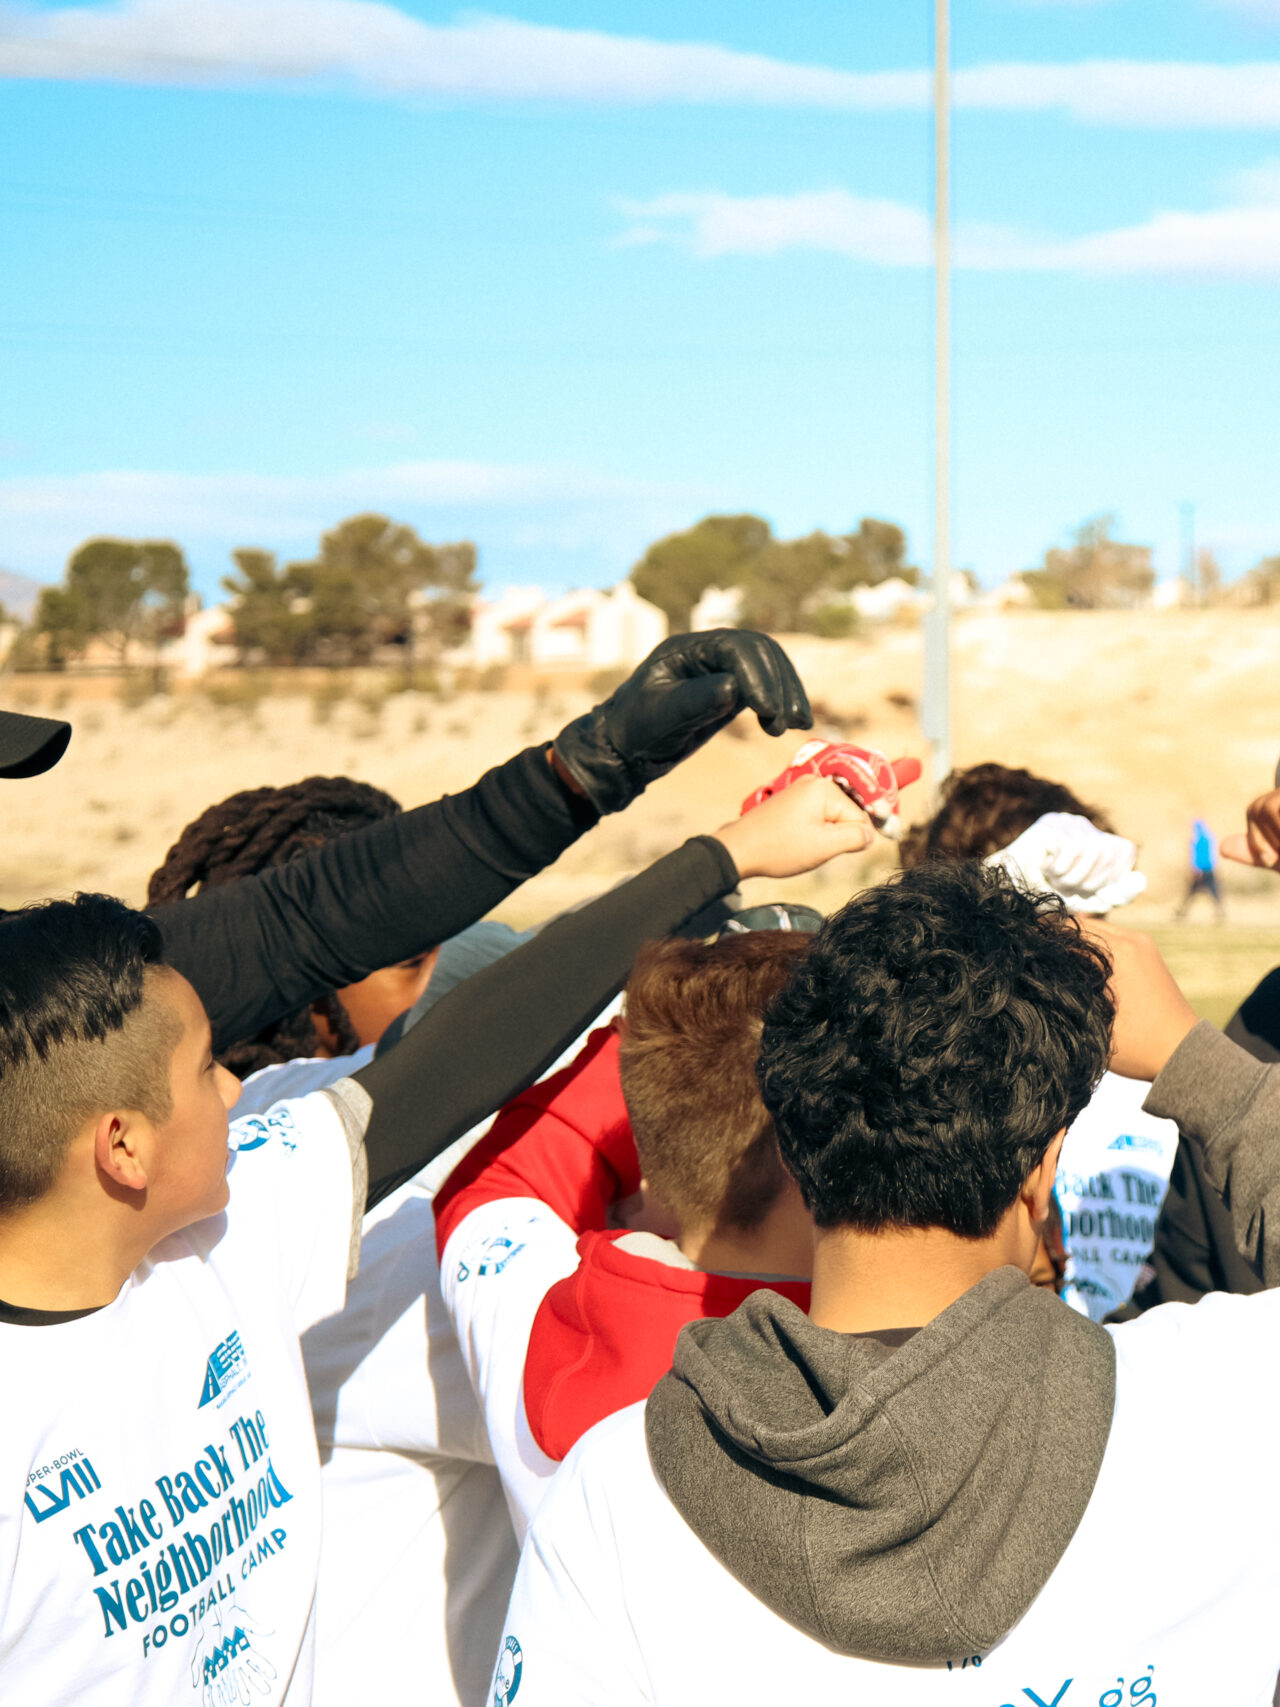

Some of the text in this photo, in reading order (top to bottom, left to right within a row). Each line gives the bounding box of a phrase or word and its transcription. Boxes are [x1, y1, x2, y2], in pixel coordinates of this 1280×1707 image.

[73, 1409, 270, 1577] Take Back The
[93, 1456, 293, 1638] Neighborhood
[143, 1528, 287, 1658] FOOTBALL CAMP
